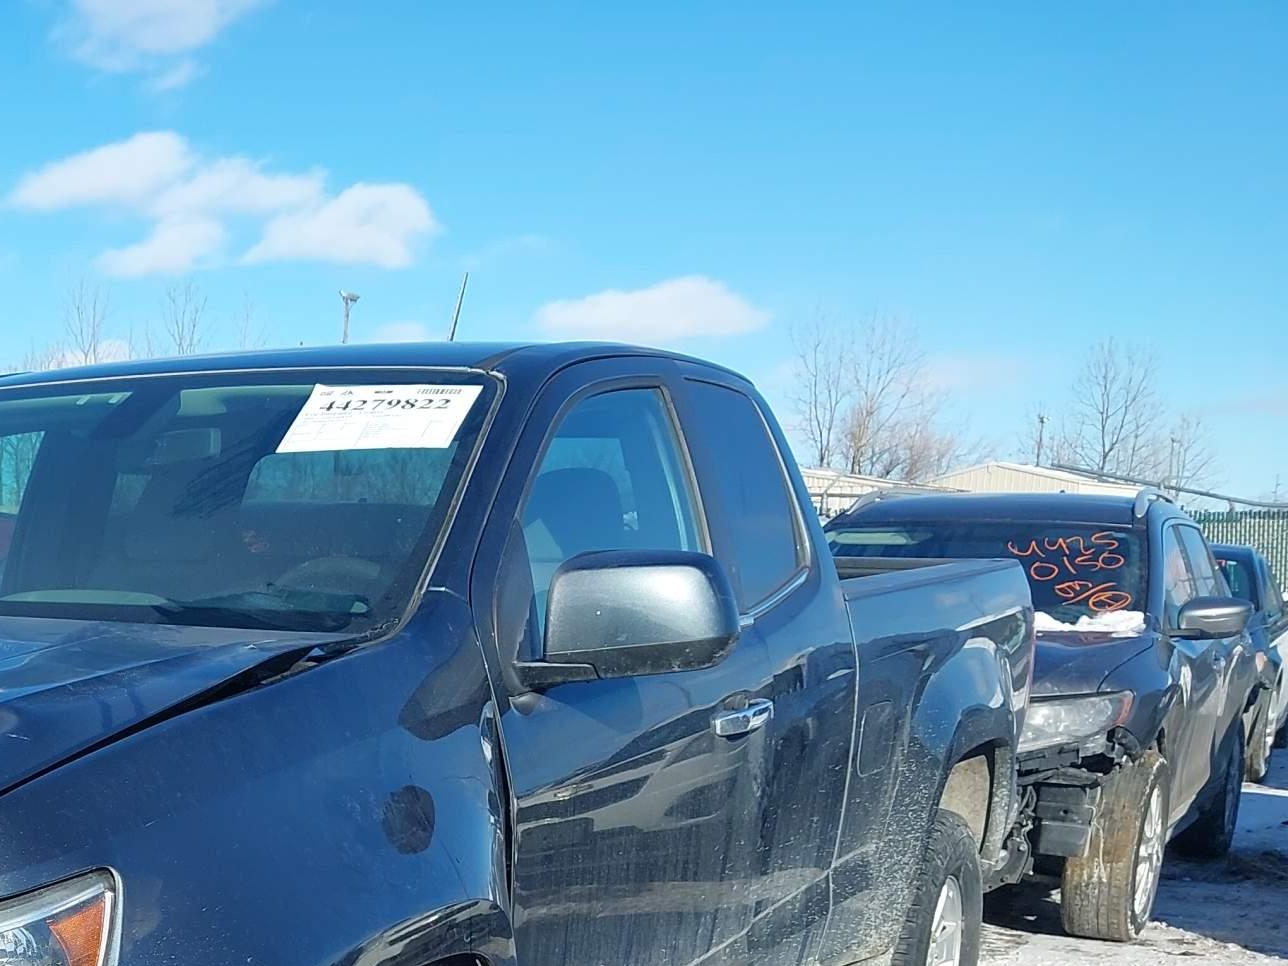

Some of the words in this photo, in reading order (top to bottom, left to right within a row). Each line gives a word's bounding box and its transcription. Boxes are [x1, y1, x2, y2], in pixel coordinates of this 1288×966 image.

[319, 398, 453, 412] 44279822
[1007, 531, 1120, 558] 4425
[1030, 551, 1125, 580] 0150
